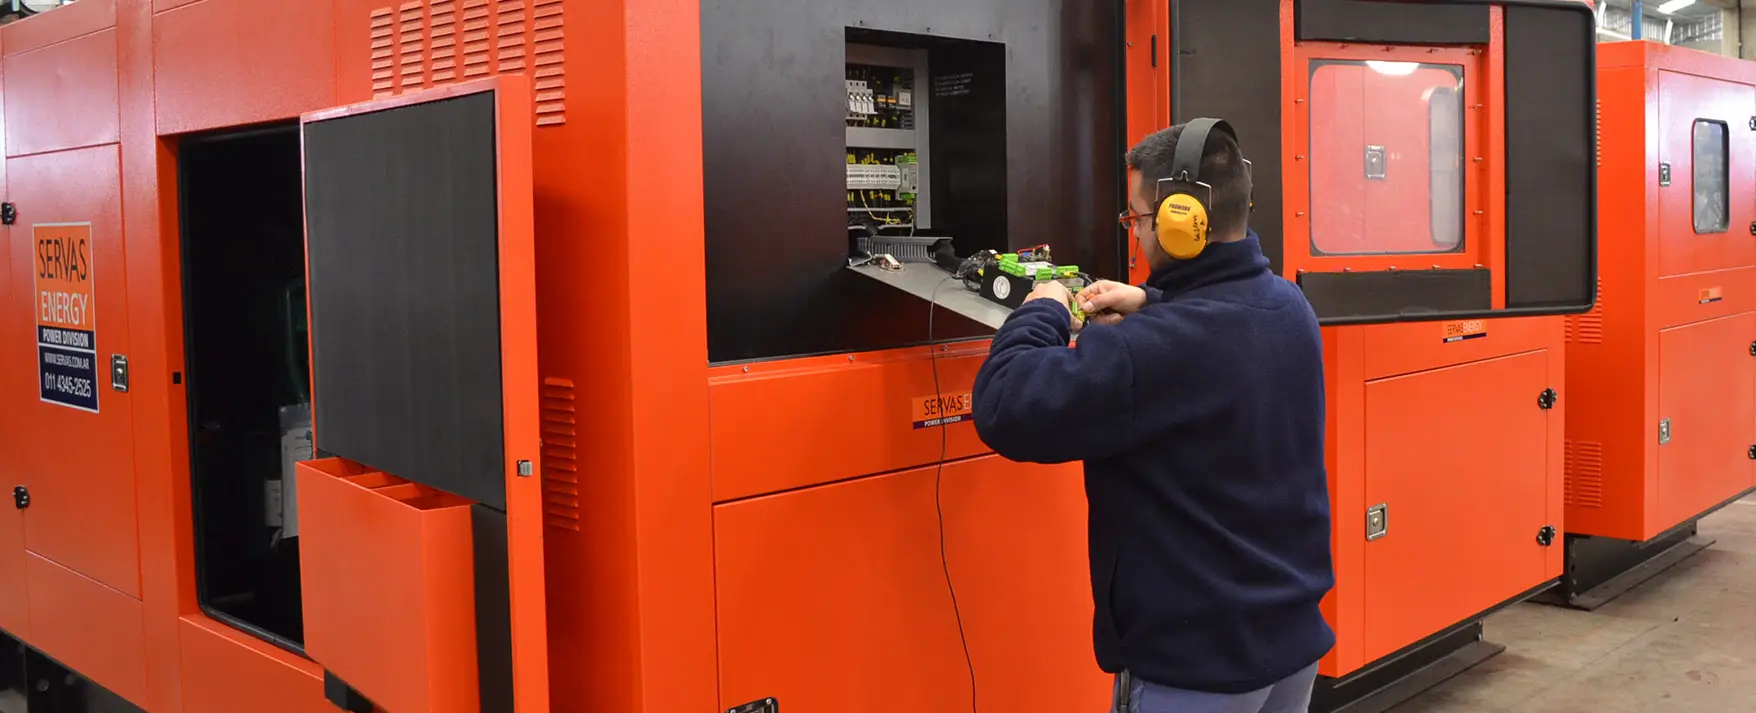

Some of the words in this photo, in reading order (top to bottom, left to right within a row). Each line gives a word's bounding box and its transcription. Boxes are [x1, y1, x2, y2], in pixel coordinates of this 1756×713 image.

[38, 237, 87, 282] SERVAS
[41, 291, 88, 325] ENERGY
[43, 328, 62, 344] POWER
[62, 330, 89, 348] DIVISION
[45, 372, 56, 390] 011
[57, 374, 92, 398] 4345-2525
[923, 395, 963, 416] SERVAS
